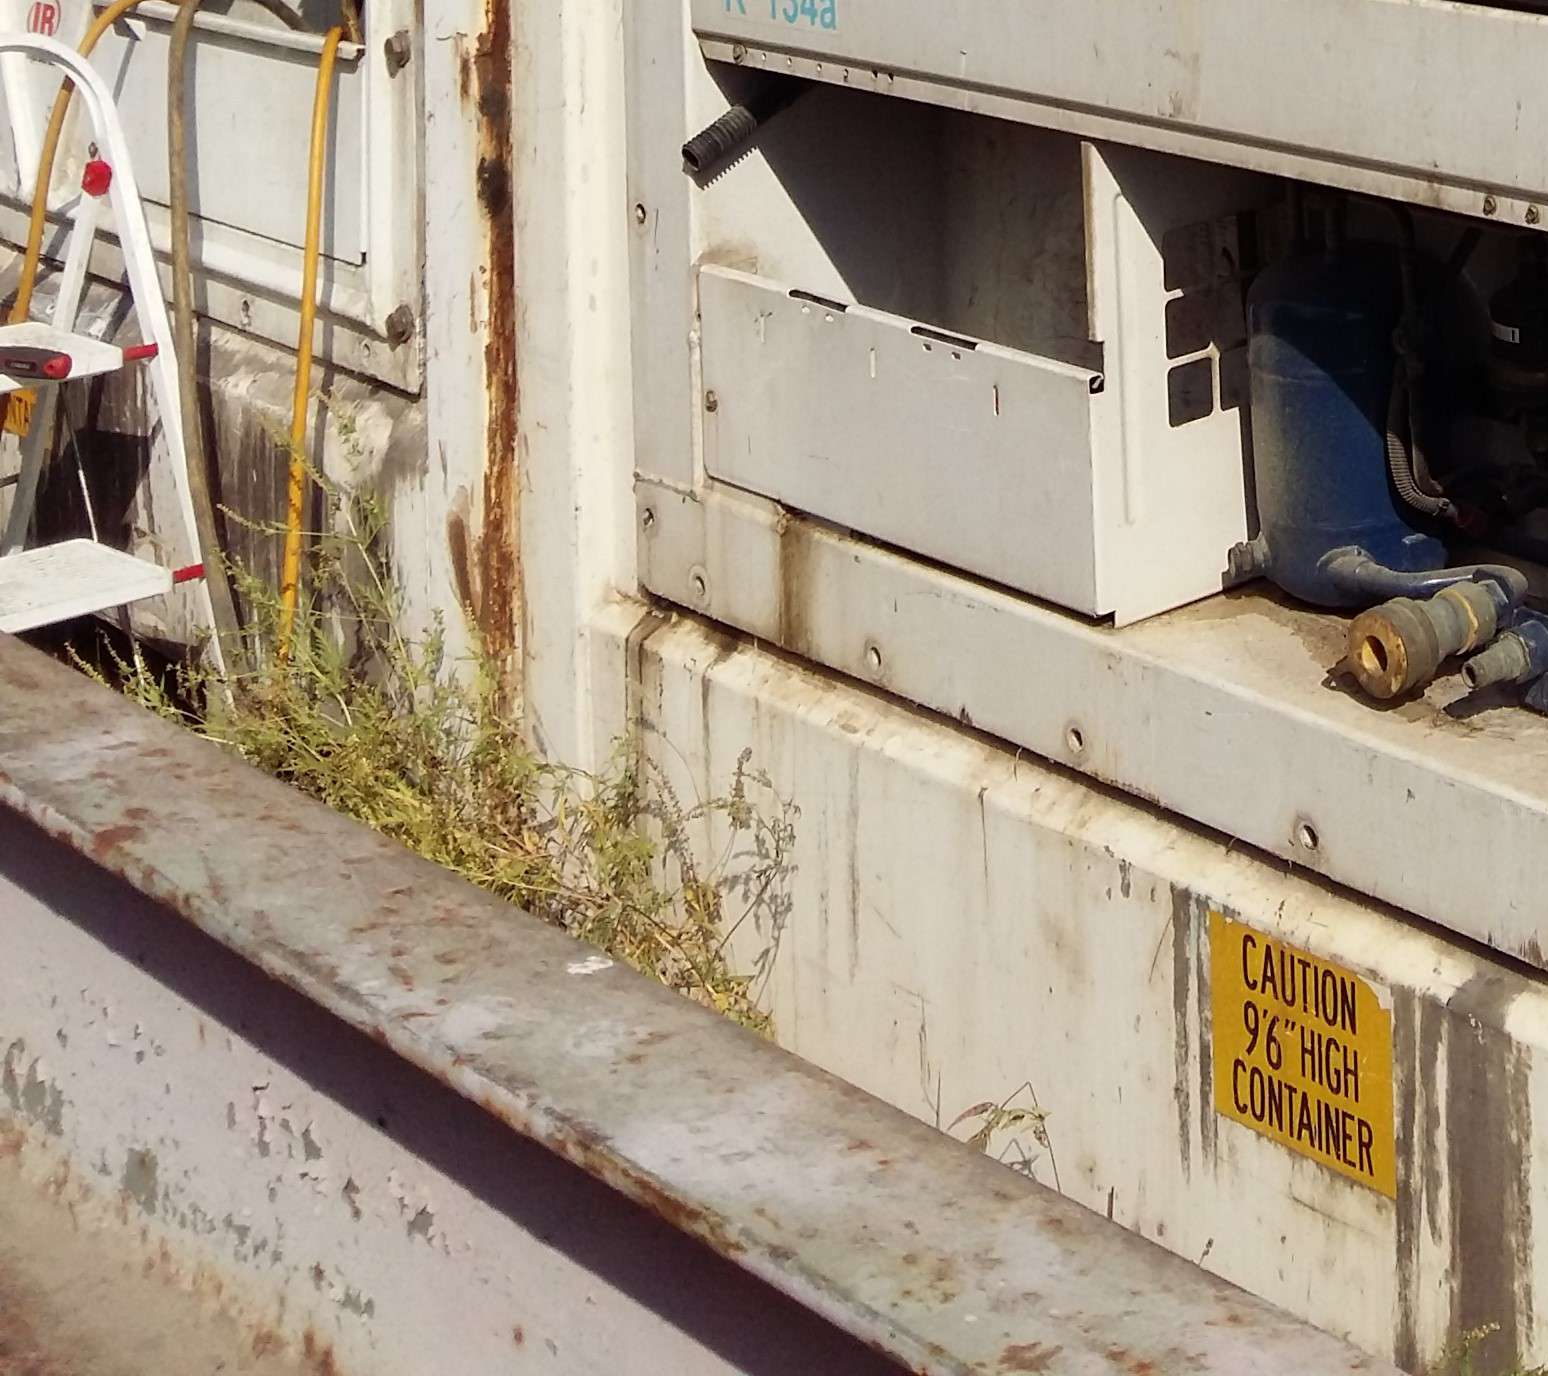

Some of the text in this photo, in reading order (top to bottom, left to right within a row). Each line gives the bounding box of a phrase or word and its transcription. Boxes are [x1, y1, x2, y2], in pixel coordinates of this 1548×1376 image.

[1241, 933, 1358, 1036] CAUTION
[1301, 1024, 1360, 1104] HIGH
[1232, 1058, 1375, 1177] CONTAINER
